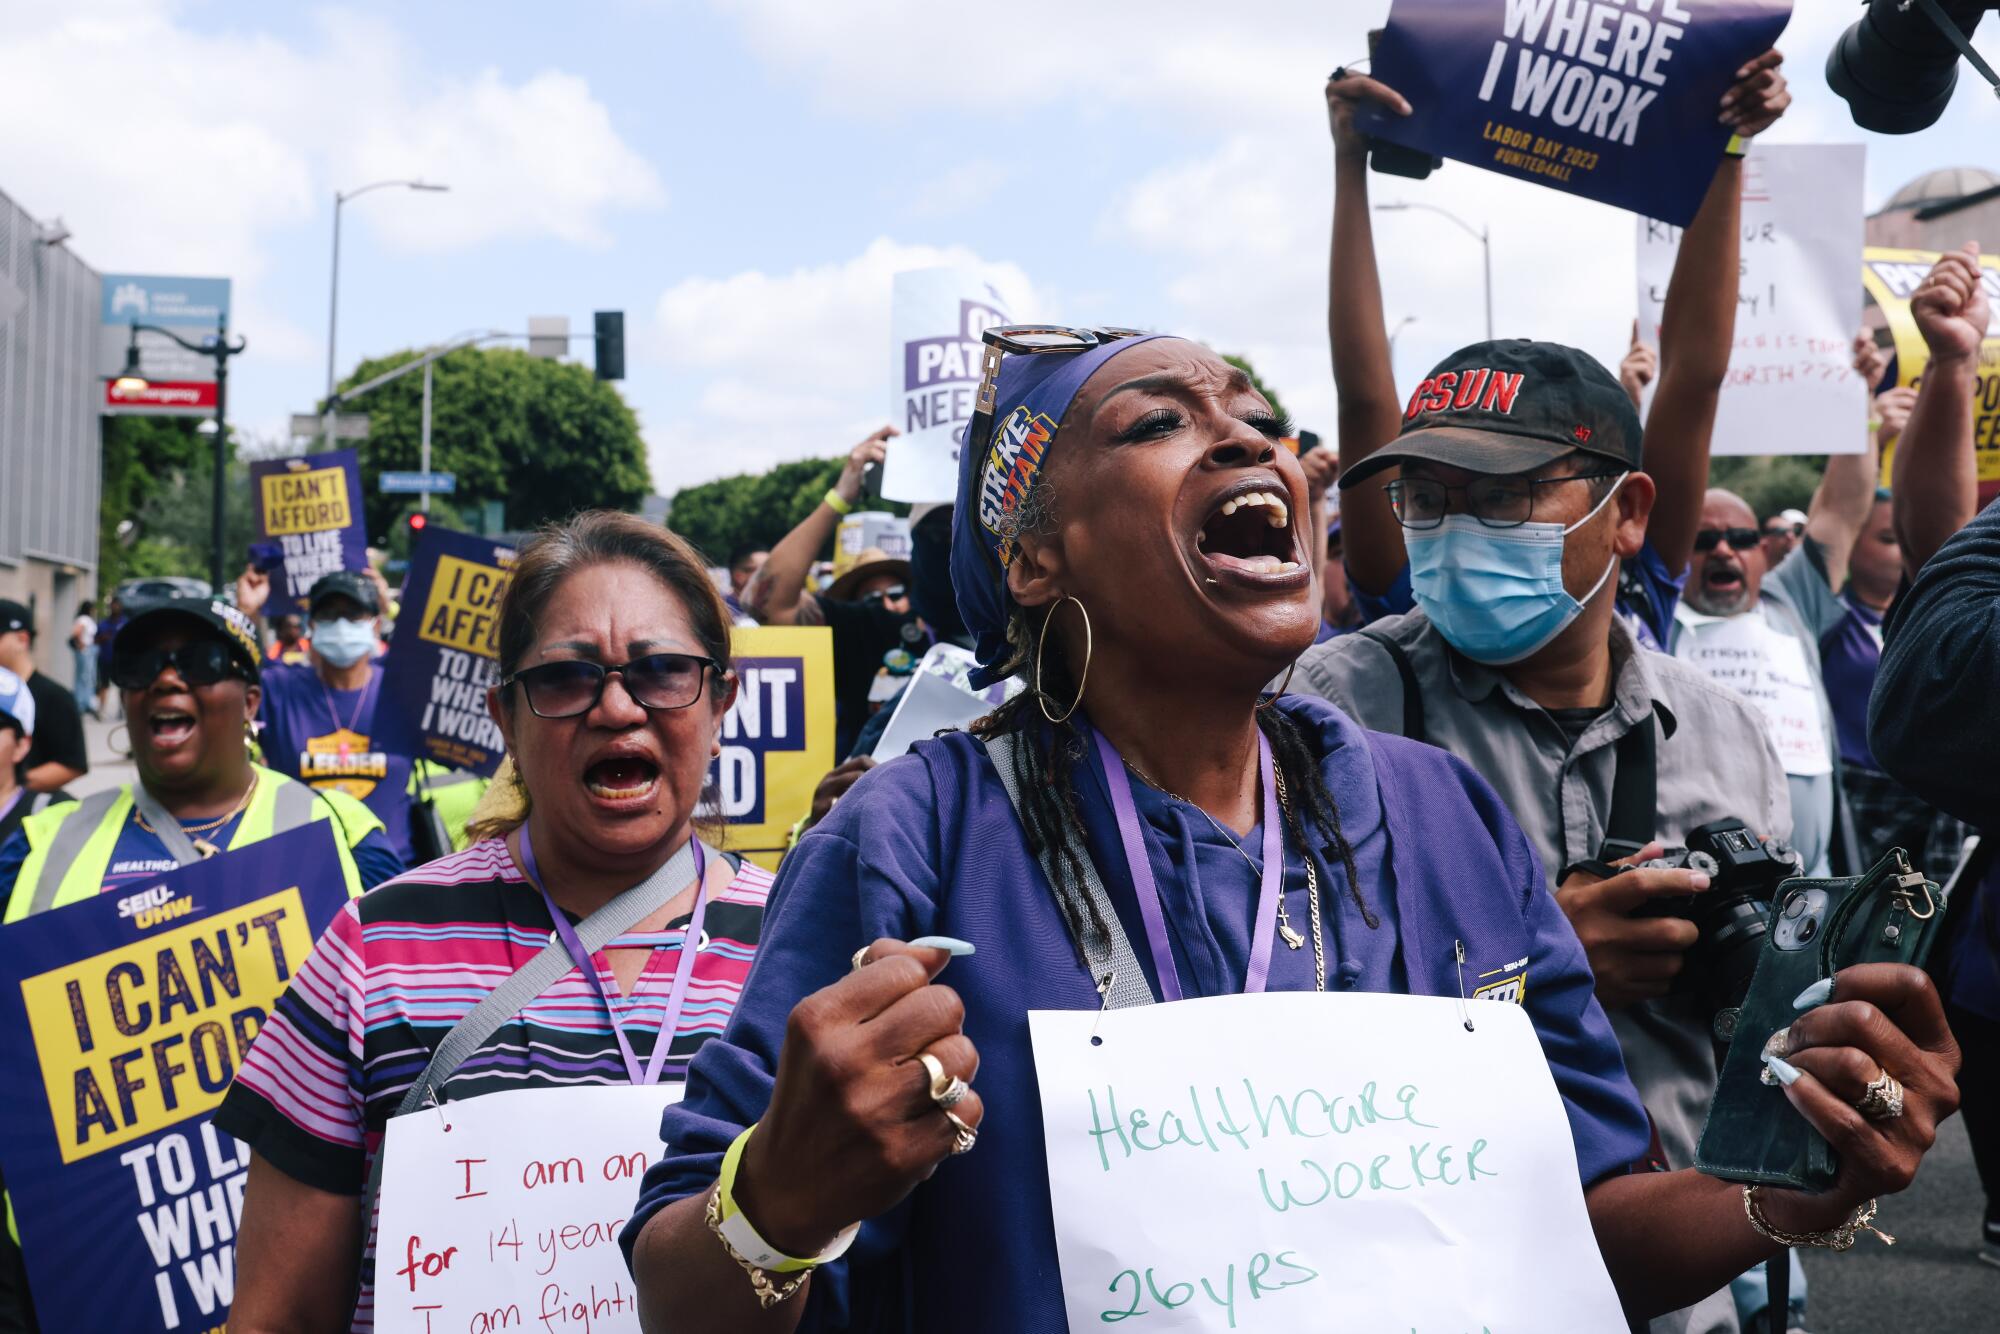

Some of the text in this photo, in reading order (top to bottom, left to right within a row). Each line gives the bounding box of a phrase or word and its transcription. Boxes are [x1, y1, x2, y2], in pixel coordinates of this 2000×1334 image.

[1503, 0, 1685, 87] WHERE
[1478, 40, 1659, 146] I WORK
[1483, 120, 1599, 171] LABOR DAY 2023
[1406, 366, 1526, 421] CSUN
[270, 474, 338, 503] I CAN'T
[979, 411, 1031, 533] STRIKE
[270, 501, 344, 530] AFFORD
[449, 567, 463, 600] I
[438, 648, 470, 681] TO
[421, 702, 435, 731] I
[134, 895, 193, 930] UHW
[66, 908, 290, 1054] I CAN'T
[120, 1133, 196, 1208] TO
[455, 1151, 647, 1200] I am an
[396, 1217, 625, 1292] for 14 year
[155, 1271, 180, 1330] I
[470, 1303, 521, 1334] am
